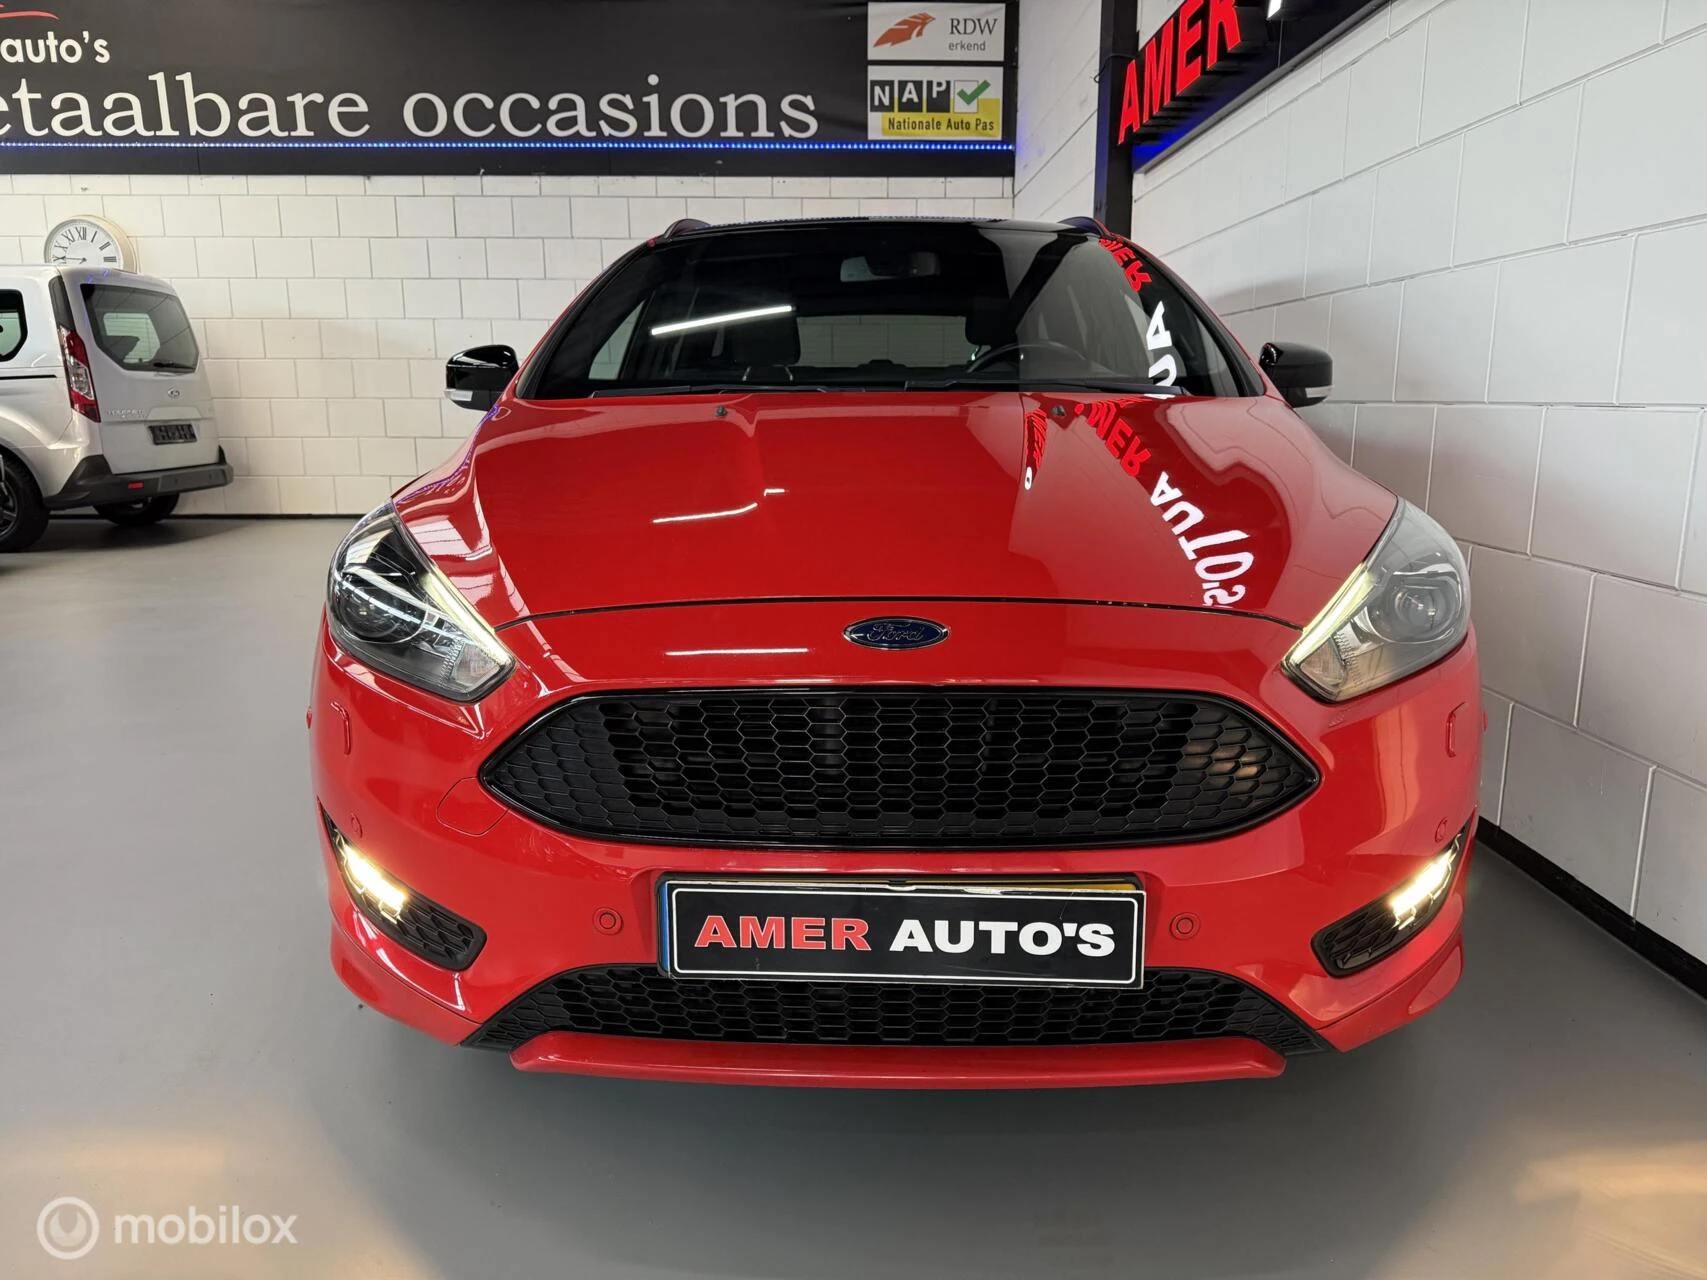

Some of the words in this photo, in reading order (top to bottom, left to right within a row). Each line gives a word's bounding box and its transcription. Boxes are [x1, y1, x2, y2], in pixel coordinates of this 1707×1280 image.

[949, 18, 998, 36] RDW
[0, 30, 111, 64] auto's
[948, 41, 986, 52] erkend
[1118, 0, 1241, 145] AMER
[0, 72, 371, 137] taalbare
[403, 74, 819, 138] occasions
[888, 117, 942, 131] Nationale
[946, 118, 971, 131] Auto
[975, 118, 995, 131] Pas
[866, 622, 924, 641] Ford
[694, 915, 872, 951] AMER
[889, 919, 1116, 957] AUTO'S
